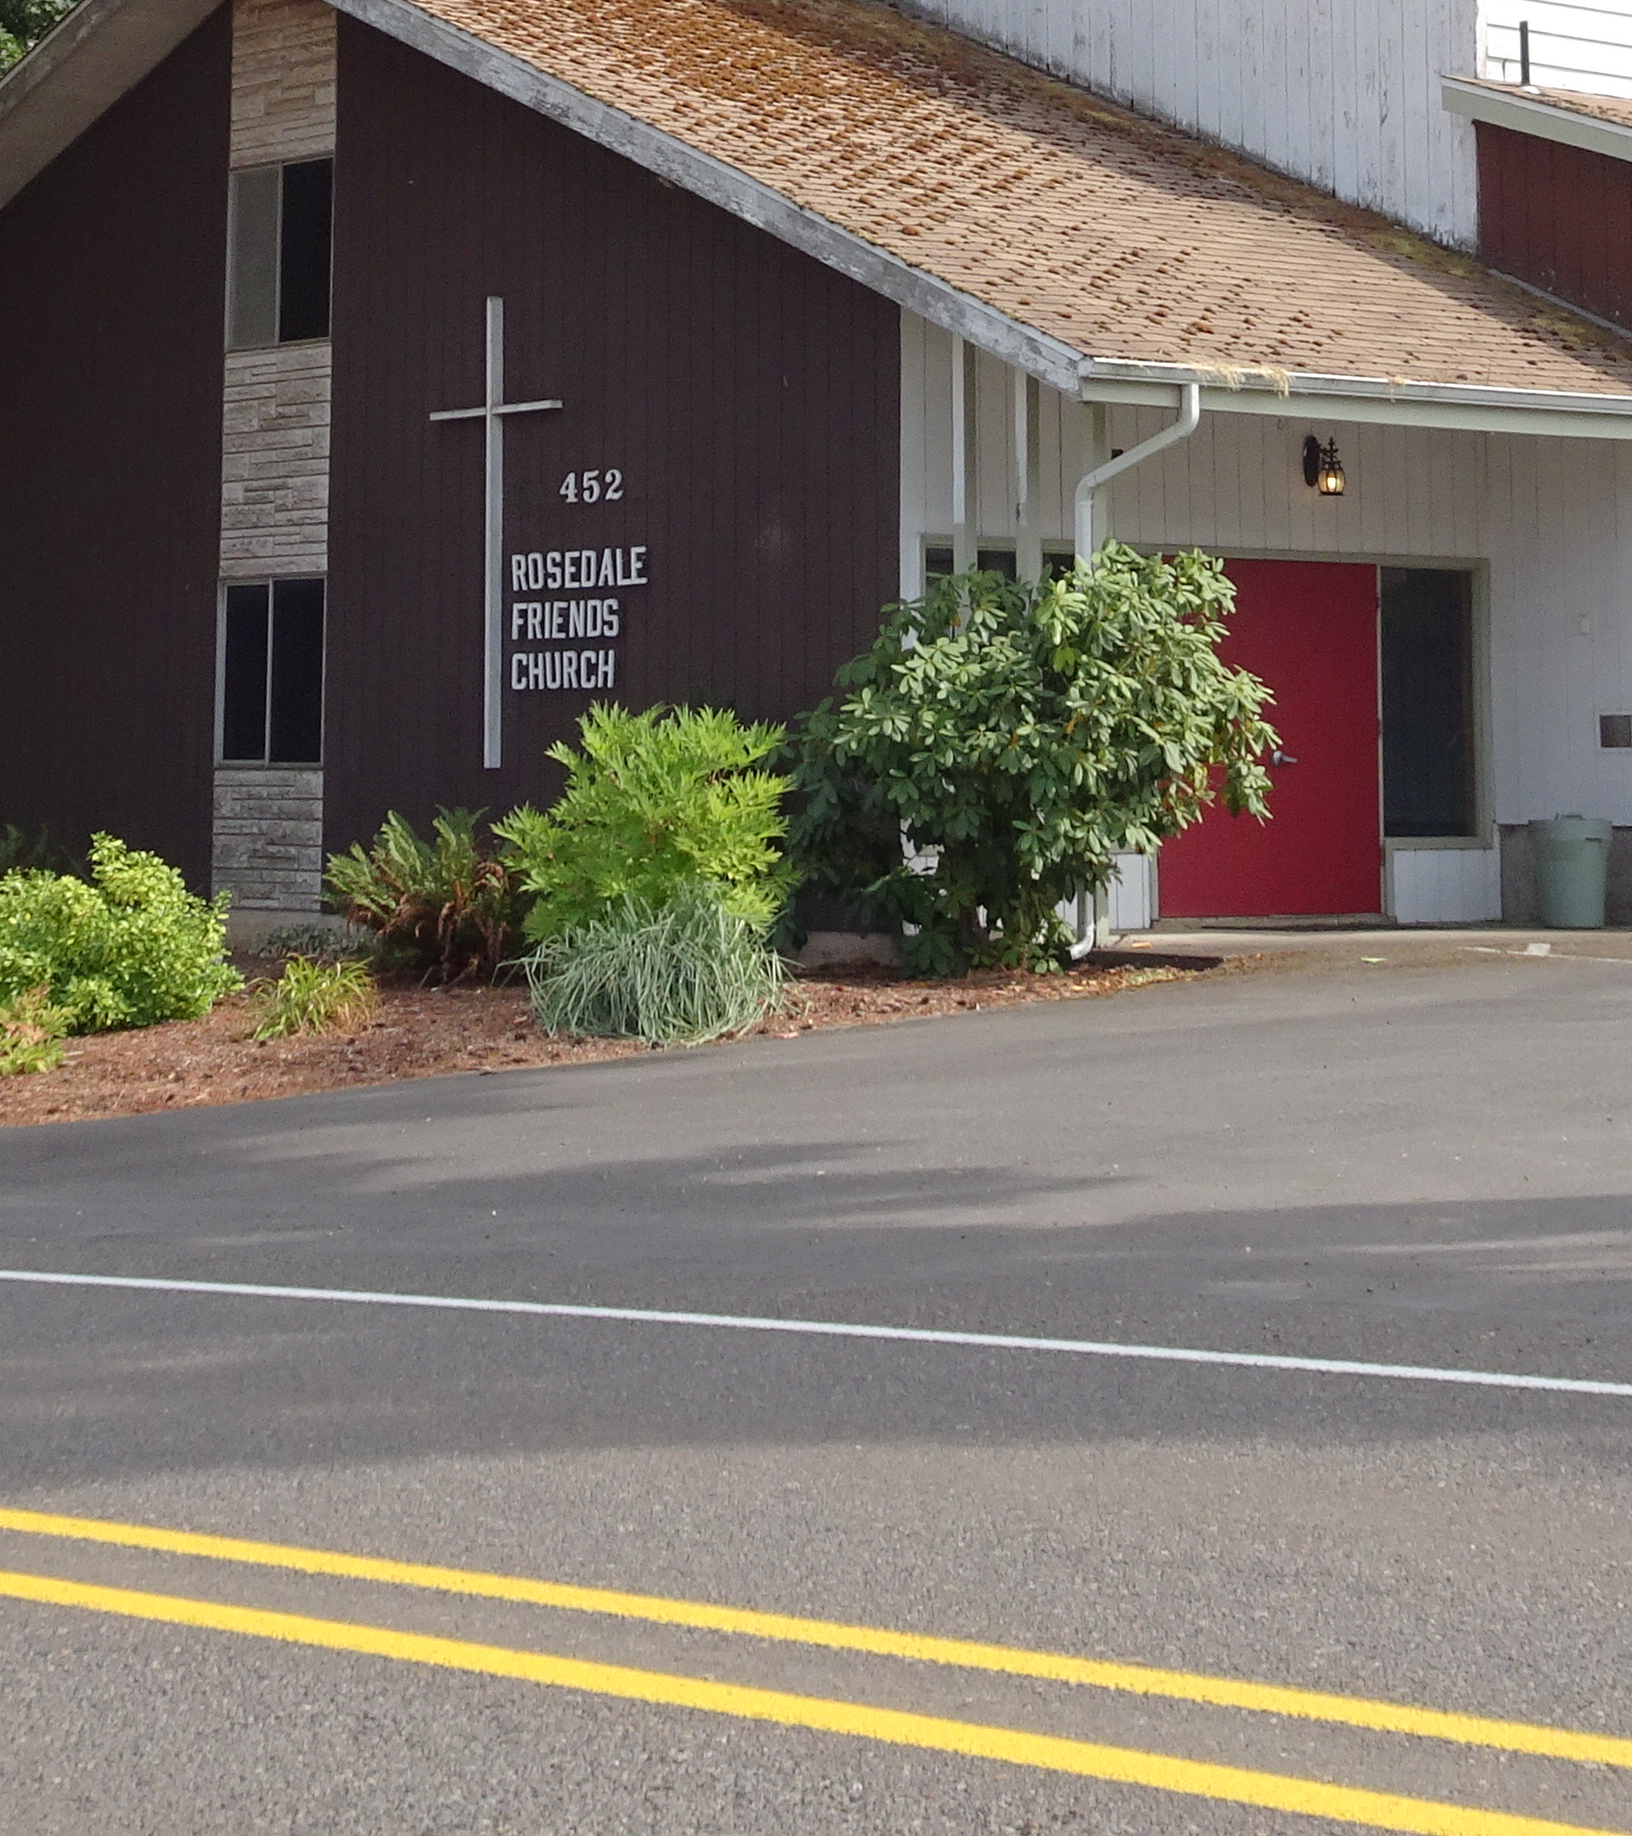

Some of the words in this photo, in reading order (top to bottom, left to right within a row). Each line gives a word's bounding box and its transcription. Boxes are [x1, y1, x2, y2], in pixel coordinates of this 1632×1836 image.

[559, 469, 624, 504] 452
[511, 545, 648, 592] ROSEDALE
[511, 598, 620, 641] FRIENDS
[511, 649, 616, 691] CHURCH
